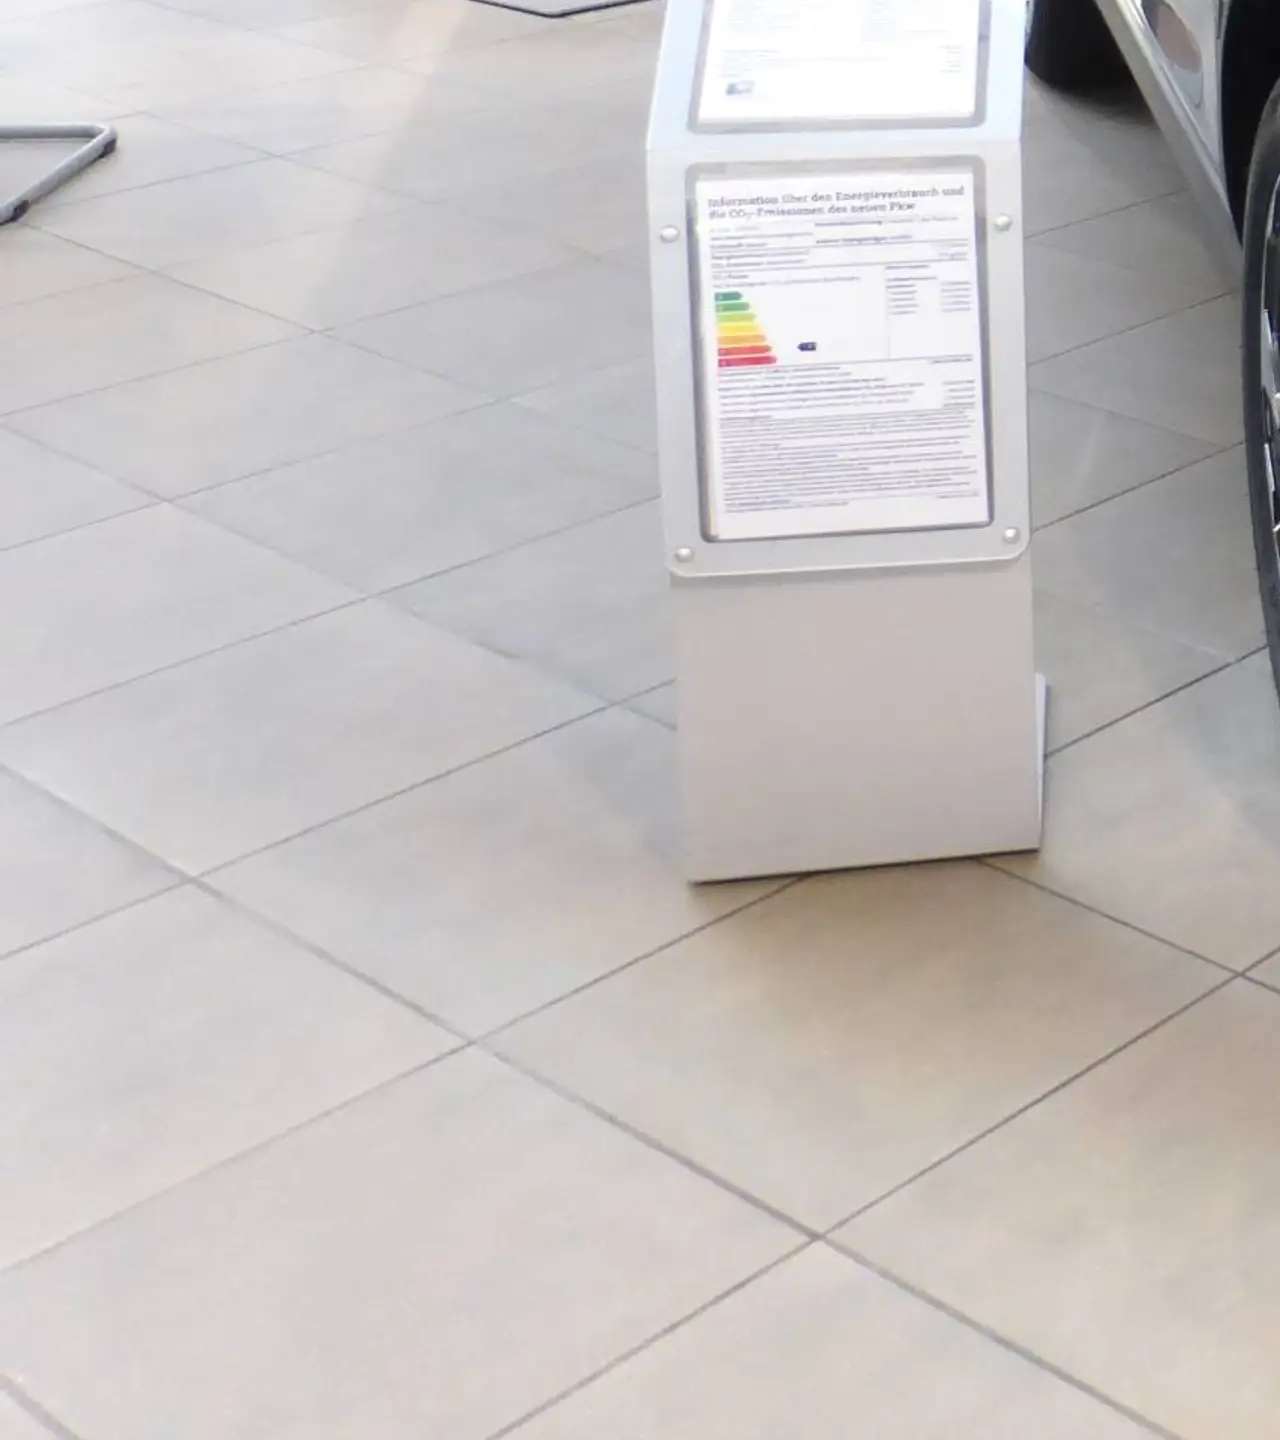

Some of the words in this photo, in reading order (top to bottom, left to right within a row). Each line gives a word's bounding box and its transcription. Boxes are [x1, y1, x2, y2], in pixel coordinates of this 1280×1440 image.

[708, 194, 779, 209] Information
[782, 192, 808, 204] über
[811, 191, 834, 203] den
[836, 187, 940, 204] Energieverbrauch
[942, 185, 965, 197] und
[708, 209, 727, 220] die
[851, 201, 887, 214] neuen
[889, 200, 917, 212] Pkw
